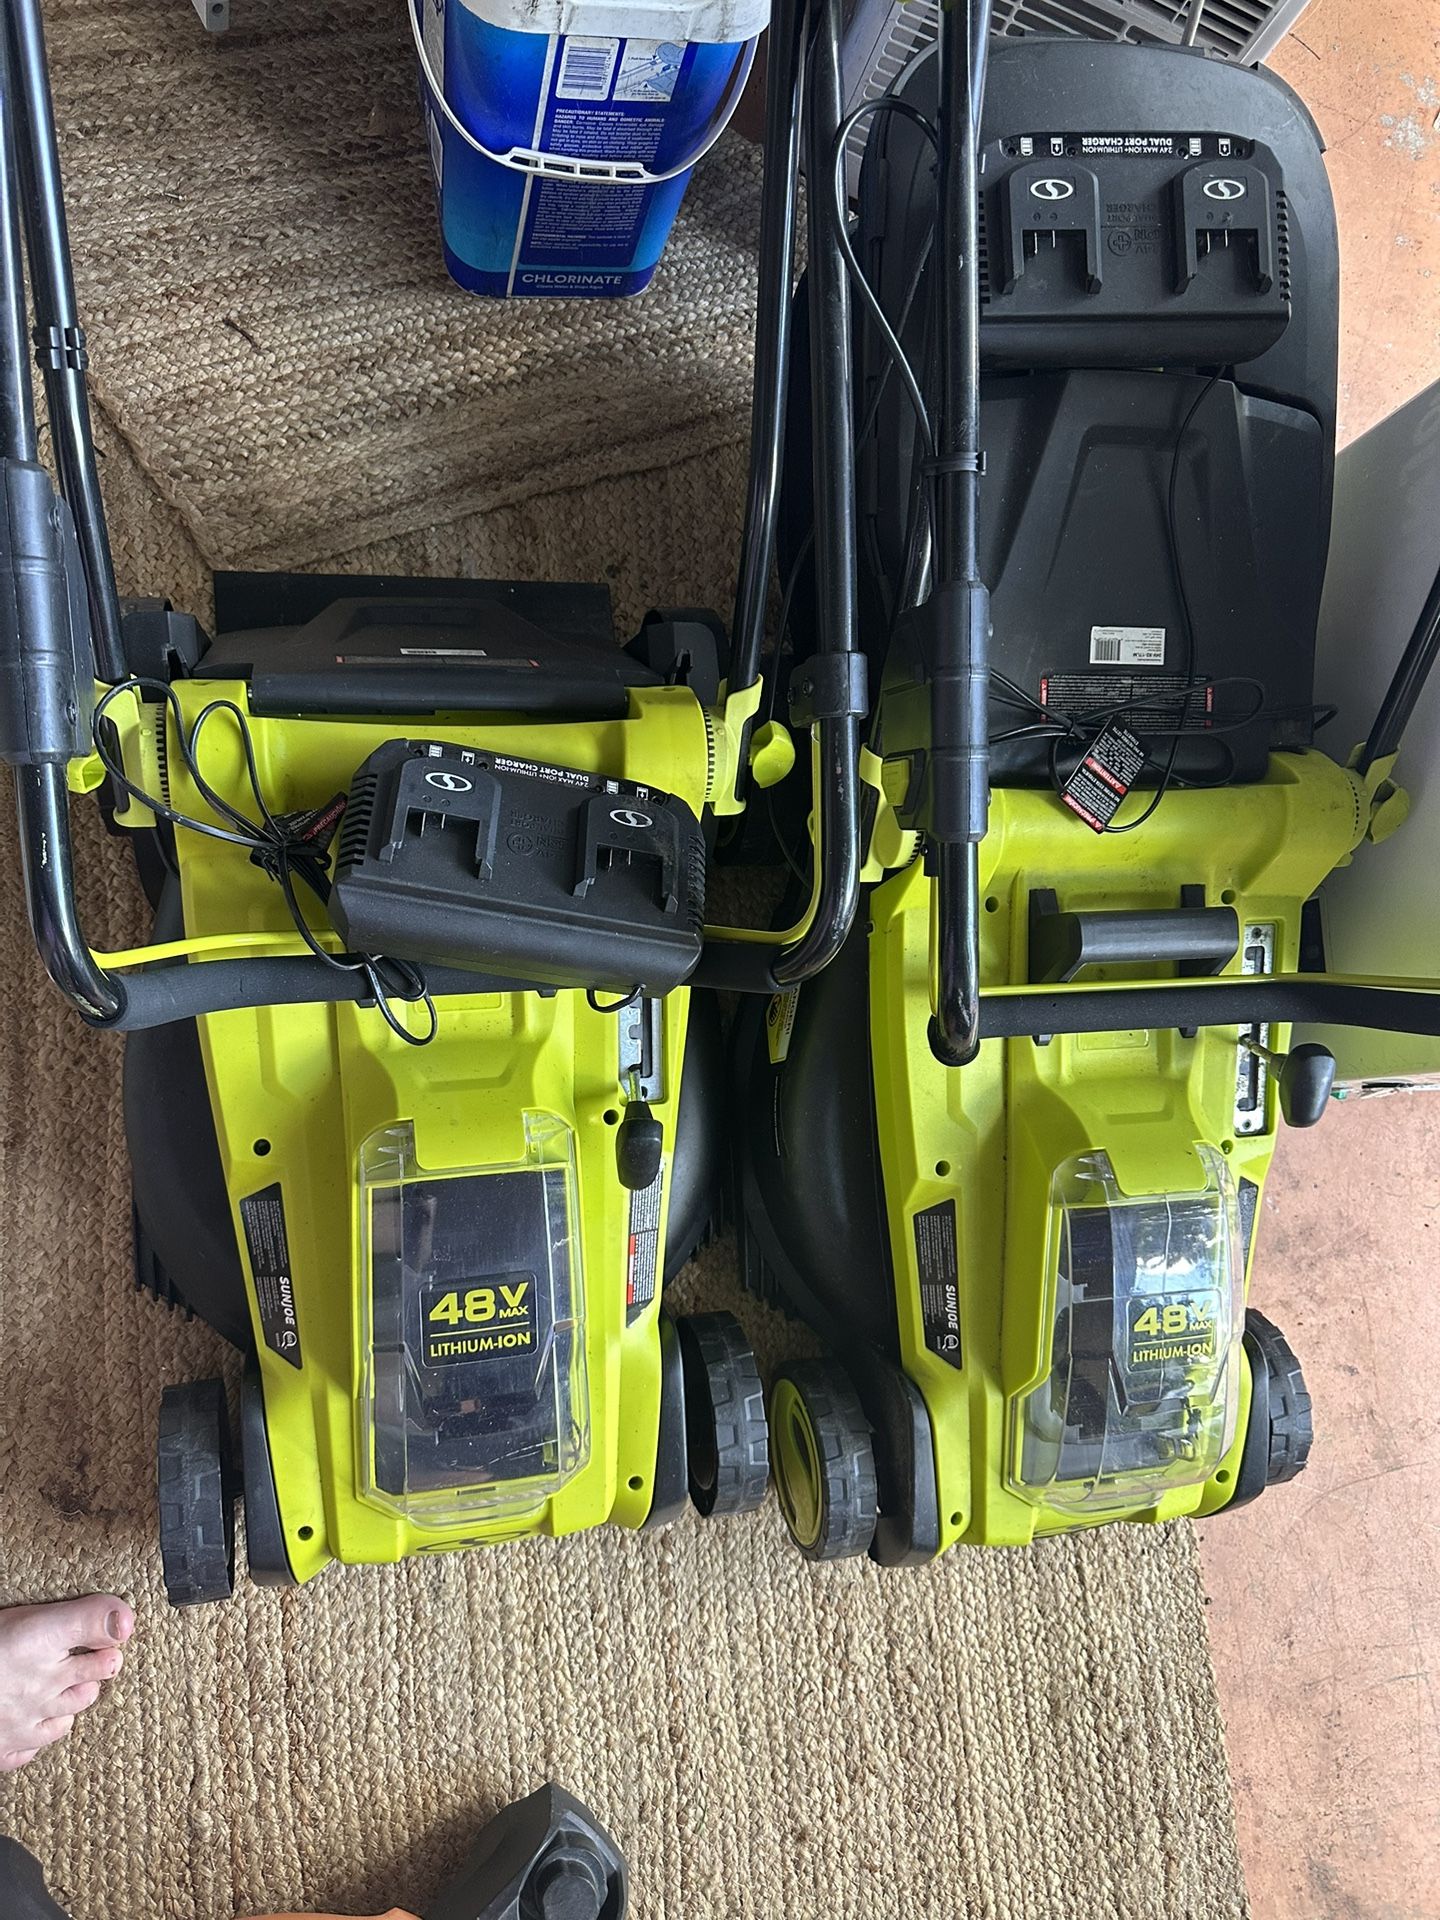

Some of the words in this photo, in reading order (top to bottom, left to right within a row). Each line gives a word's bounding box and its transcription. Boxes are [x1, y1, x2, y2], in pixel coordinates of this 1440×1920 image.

[1082, 137, 1124, 146] CHARGER
[1124, 137, 1147, 146] PORT
[1149, 137, 1172, 146] DUAL
[1082, 146, 1123, 154] LITHIUM-ION
[1142, 146, 1159, 154] MAX
[1159, 146, 1173, 154] 24V
[521, 273, 623, 285] CHLORINATE
[495, 757, 539, 771] CHARGER
[495, 764, 537, 777] LITHIUM-ION
[540, 767, 564, 777] PORT
[558, 776, 574, 785] MAX
[565, 771, 590, 783] DUAL
[575, 780, 590, 788] 24V
[279, 1276, 295, 1326] SUNJOE
[429, 1288, 496, 1326] 48
[498, 1282, 530, 1308] V
[499, 1305, 530, 1320] MAX
[945, 1284, 959, 1332] SUNJOE
[1133, 1303, 1189, 1336] 48
[1191, 1301, 1212, 1322] V
[1189, 1318, 1213, 1331] MAX
[429, 1331, 532, 1359] LITHIUM-ION
[1133, 1340, 1214, 1364] LITHIUM-ION
